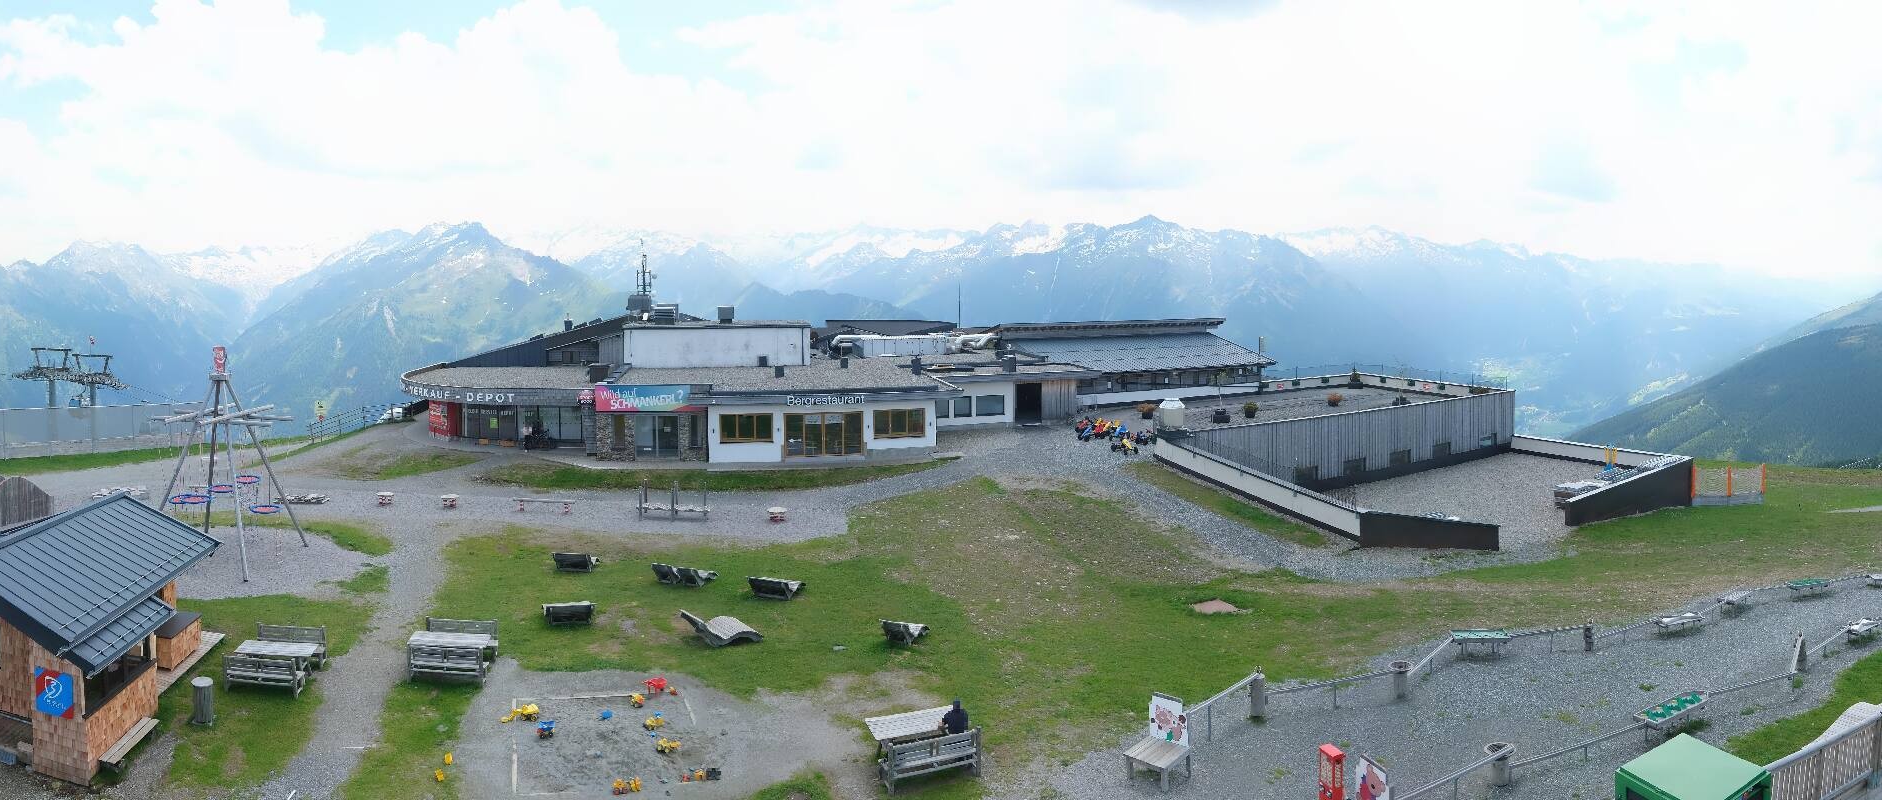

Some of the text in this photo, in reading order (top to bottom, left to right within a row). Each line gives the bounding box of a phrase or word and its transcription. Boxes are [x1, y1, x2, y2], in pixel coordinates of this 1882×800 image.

[409, 386, 451, 399] VERKAUF
[466, 393, 515, 403] DEPOT
[601, 388, 638, 400] Wild auf
[787, 395, 865, 407] Bergrestaurant
